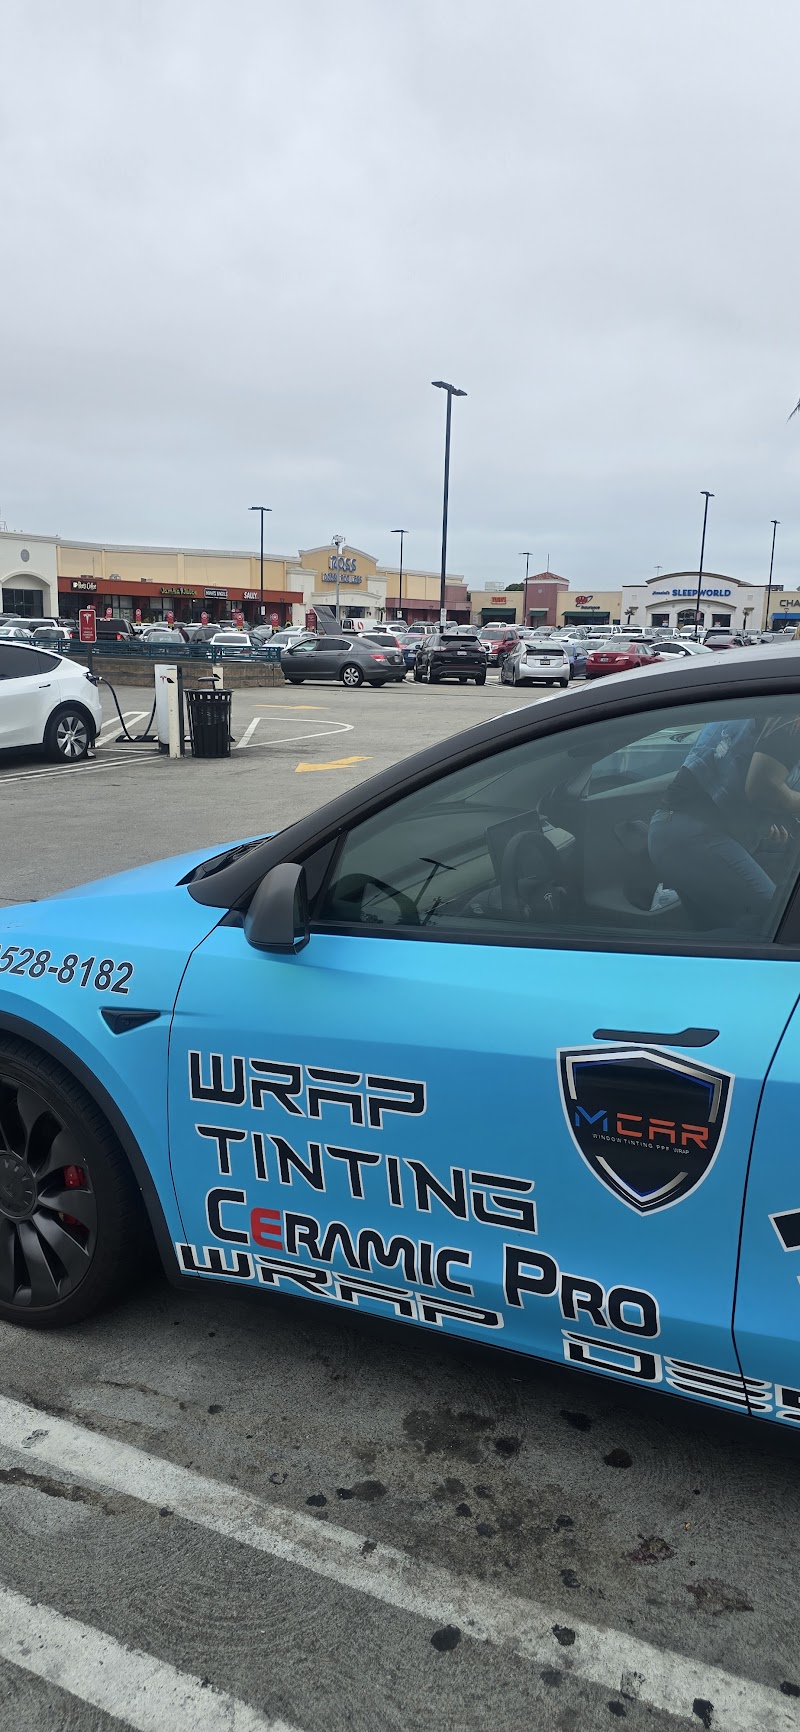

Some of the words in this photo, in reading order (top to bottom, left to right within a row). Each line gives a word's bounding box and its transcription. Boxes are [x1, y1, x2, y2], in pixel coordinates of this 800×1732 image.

[329, 556, 356, 572] ROSS
[244, 591, 257, 599] SALLY
[188, 1050, 427, 1130] WRAP
[592, 1133, 622, 1143] WINDOW
[624, 1138, 653, 1149] TINTING
[673, 1147, 690, 1155] WRAP
[195, 1124, 538, 1234] TINTING
[175, 1242, 505, 1329] WRAP
